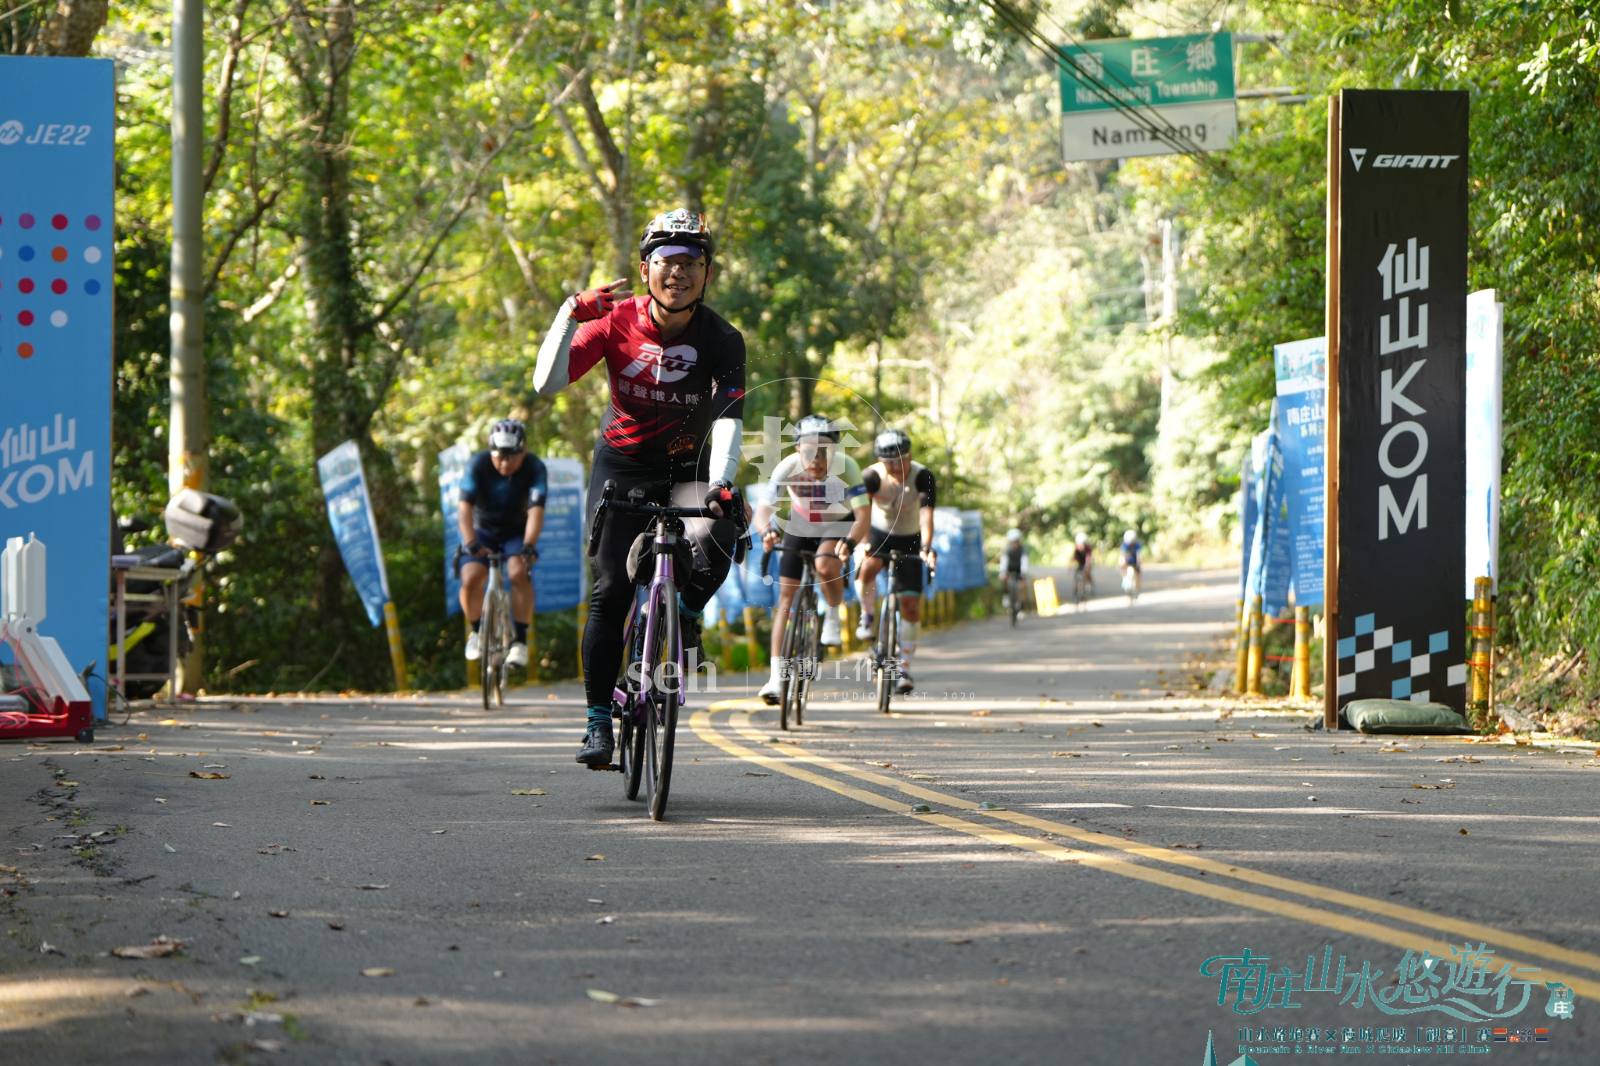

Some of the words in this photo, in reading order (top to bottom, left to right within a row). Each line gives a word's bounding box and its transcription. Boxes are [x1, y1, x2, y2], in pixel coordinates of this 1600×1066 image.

[1155, 79, 1218, 98] Township
[25, 123, 92, 145] JE22
[1372, 154, 1460, 169] GIANT
[1377, 237, 1430, 356] 仙山
[0, 412, 76, 469] 仙山
[1378, 358, 1429, 541] KOM
